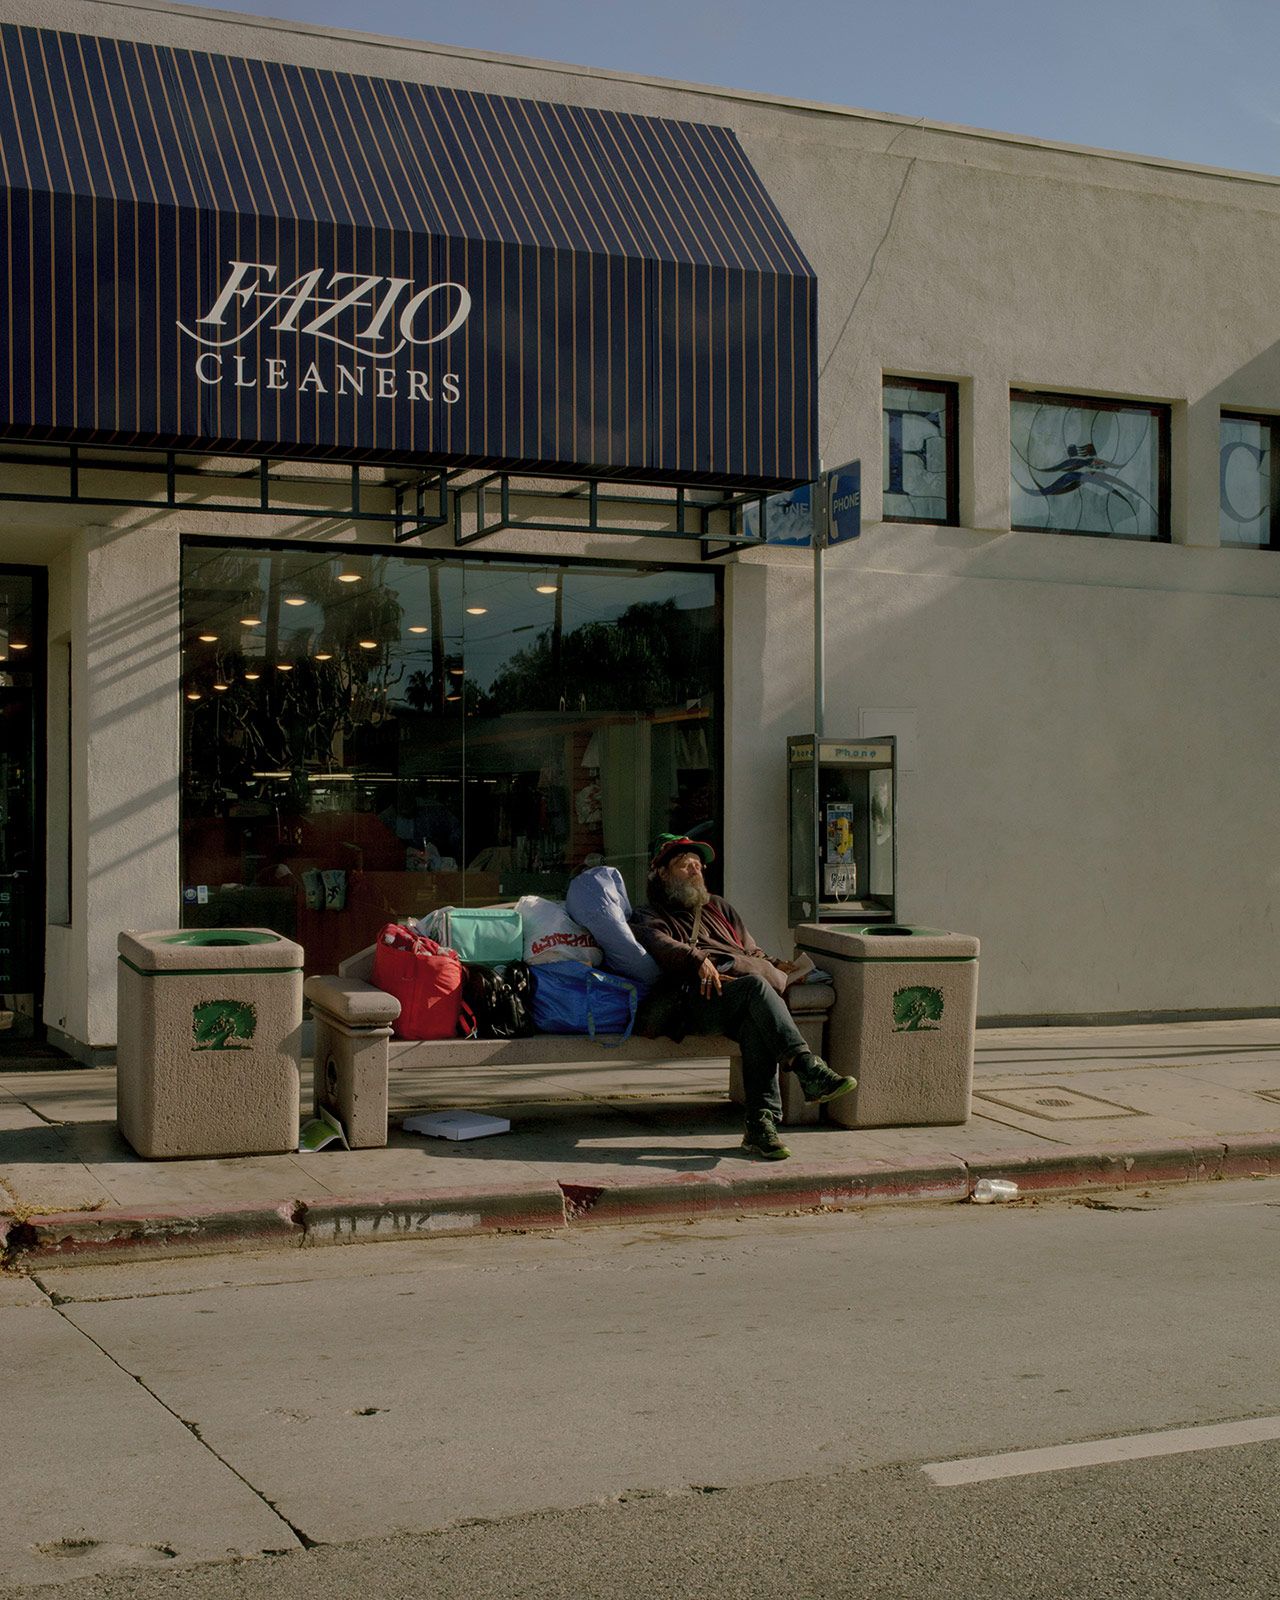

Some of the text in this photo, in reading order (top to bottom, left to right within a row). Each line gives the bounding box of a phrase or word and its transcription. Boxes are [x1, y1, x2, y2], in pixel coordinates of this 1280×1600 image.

[176, 261, 472, 358] FAZIO
[195, 352, 461, 403] CLEANERS
[833, 491, 860, 513] PHONE
[835, 747, 876, 758] Phone
